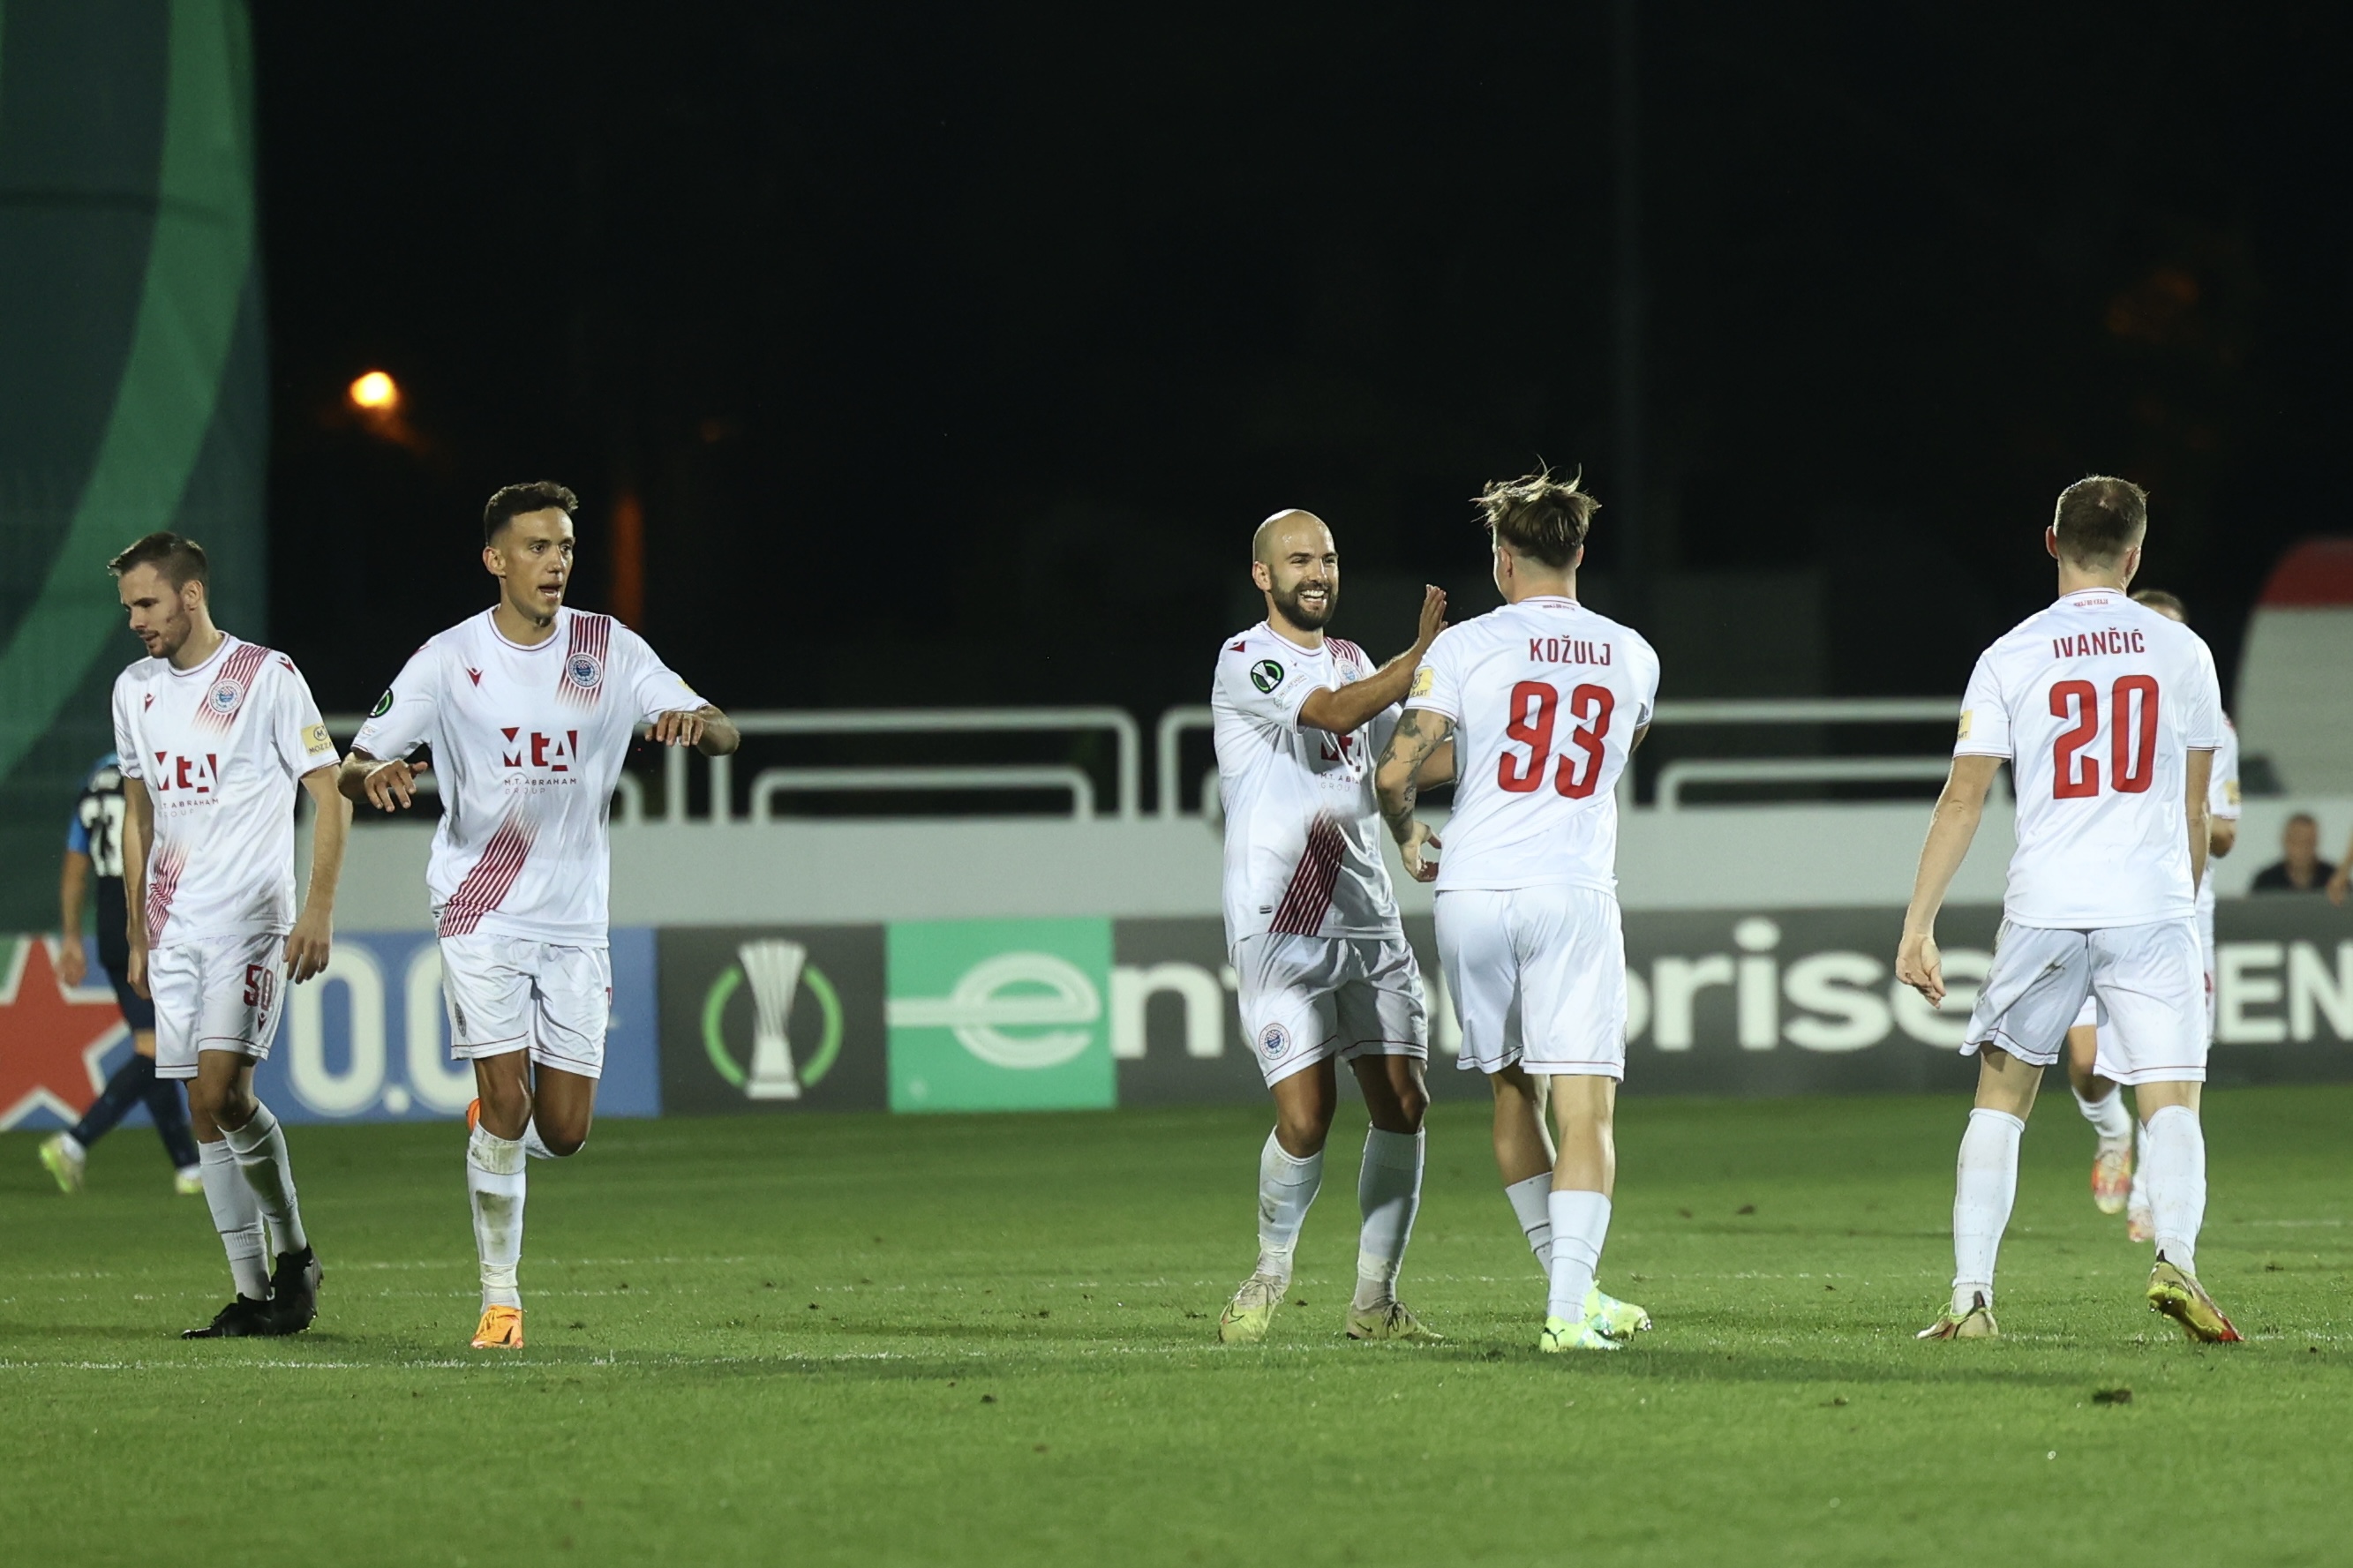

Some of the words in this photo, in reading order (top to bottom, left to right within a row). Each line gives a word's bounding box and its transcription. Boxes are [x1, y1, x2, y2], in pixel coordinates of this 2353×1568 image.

[1530, 634, 1611, 666] KOŽULJ
[2052, 627, 2146, 659] IVANČIĆ
[1497, 680, 1616, 800] 93
[2049, 674, 2160, 800] 20
[171, 799, 219, 808] ABRAHAM
[243, 963, 274, 1011] 50
